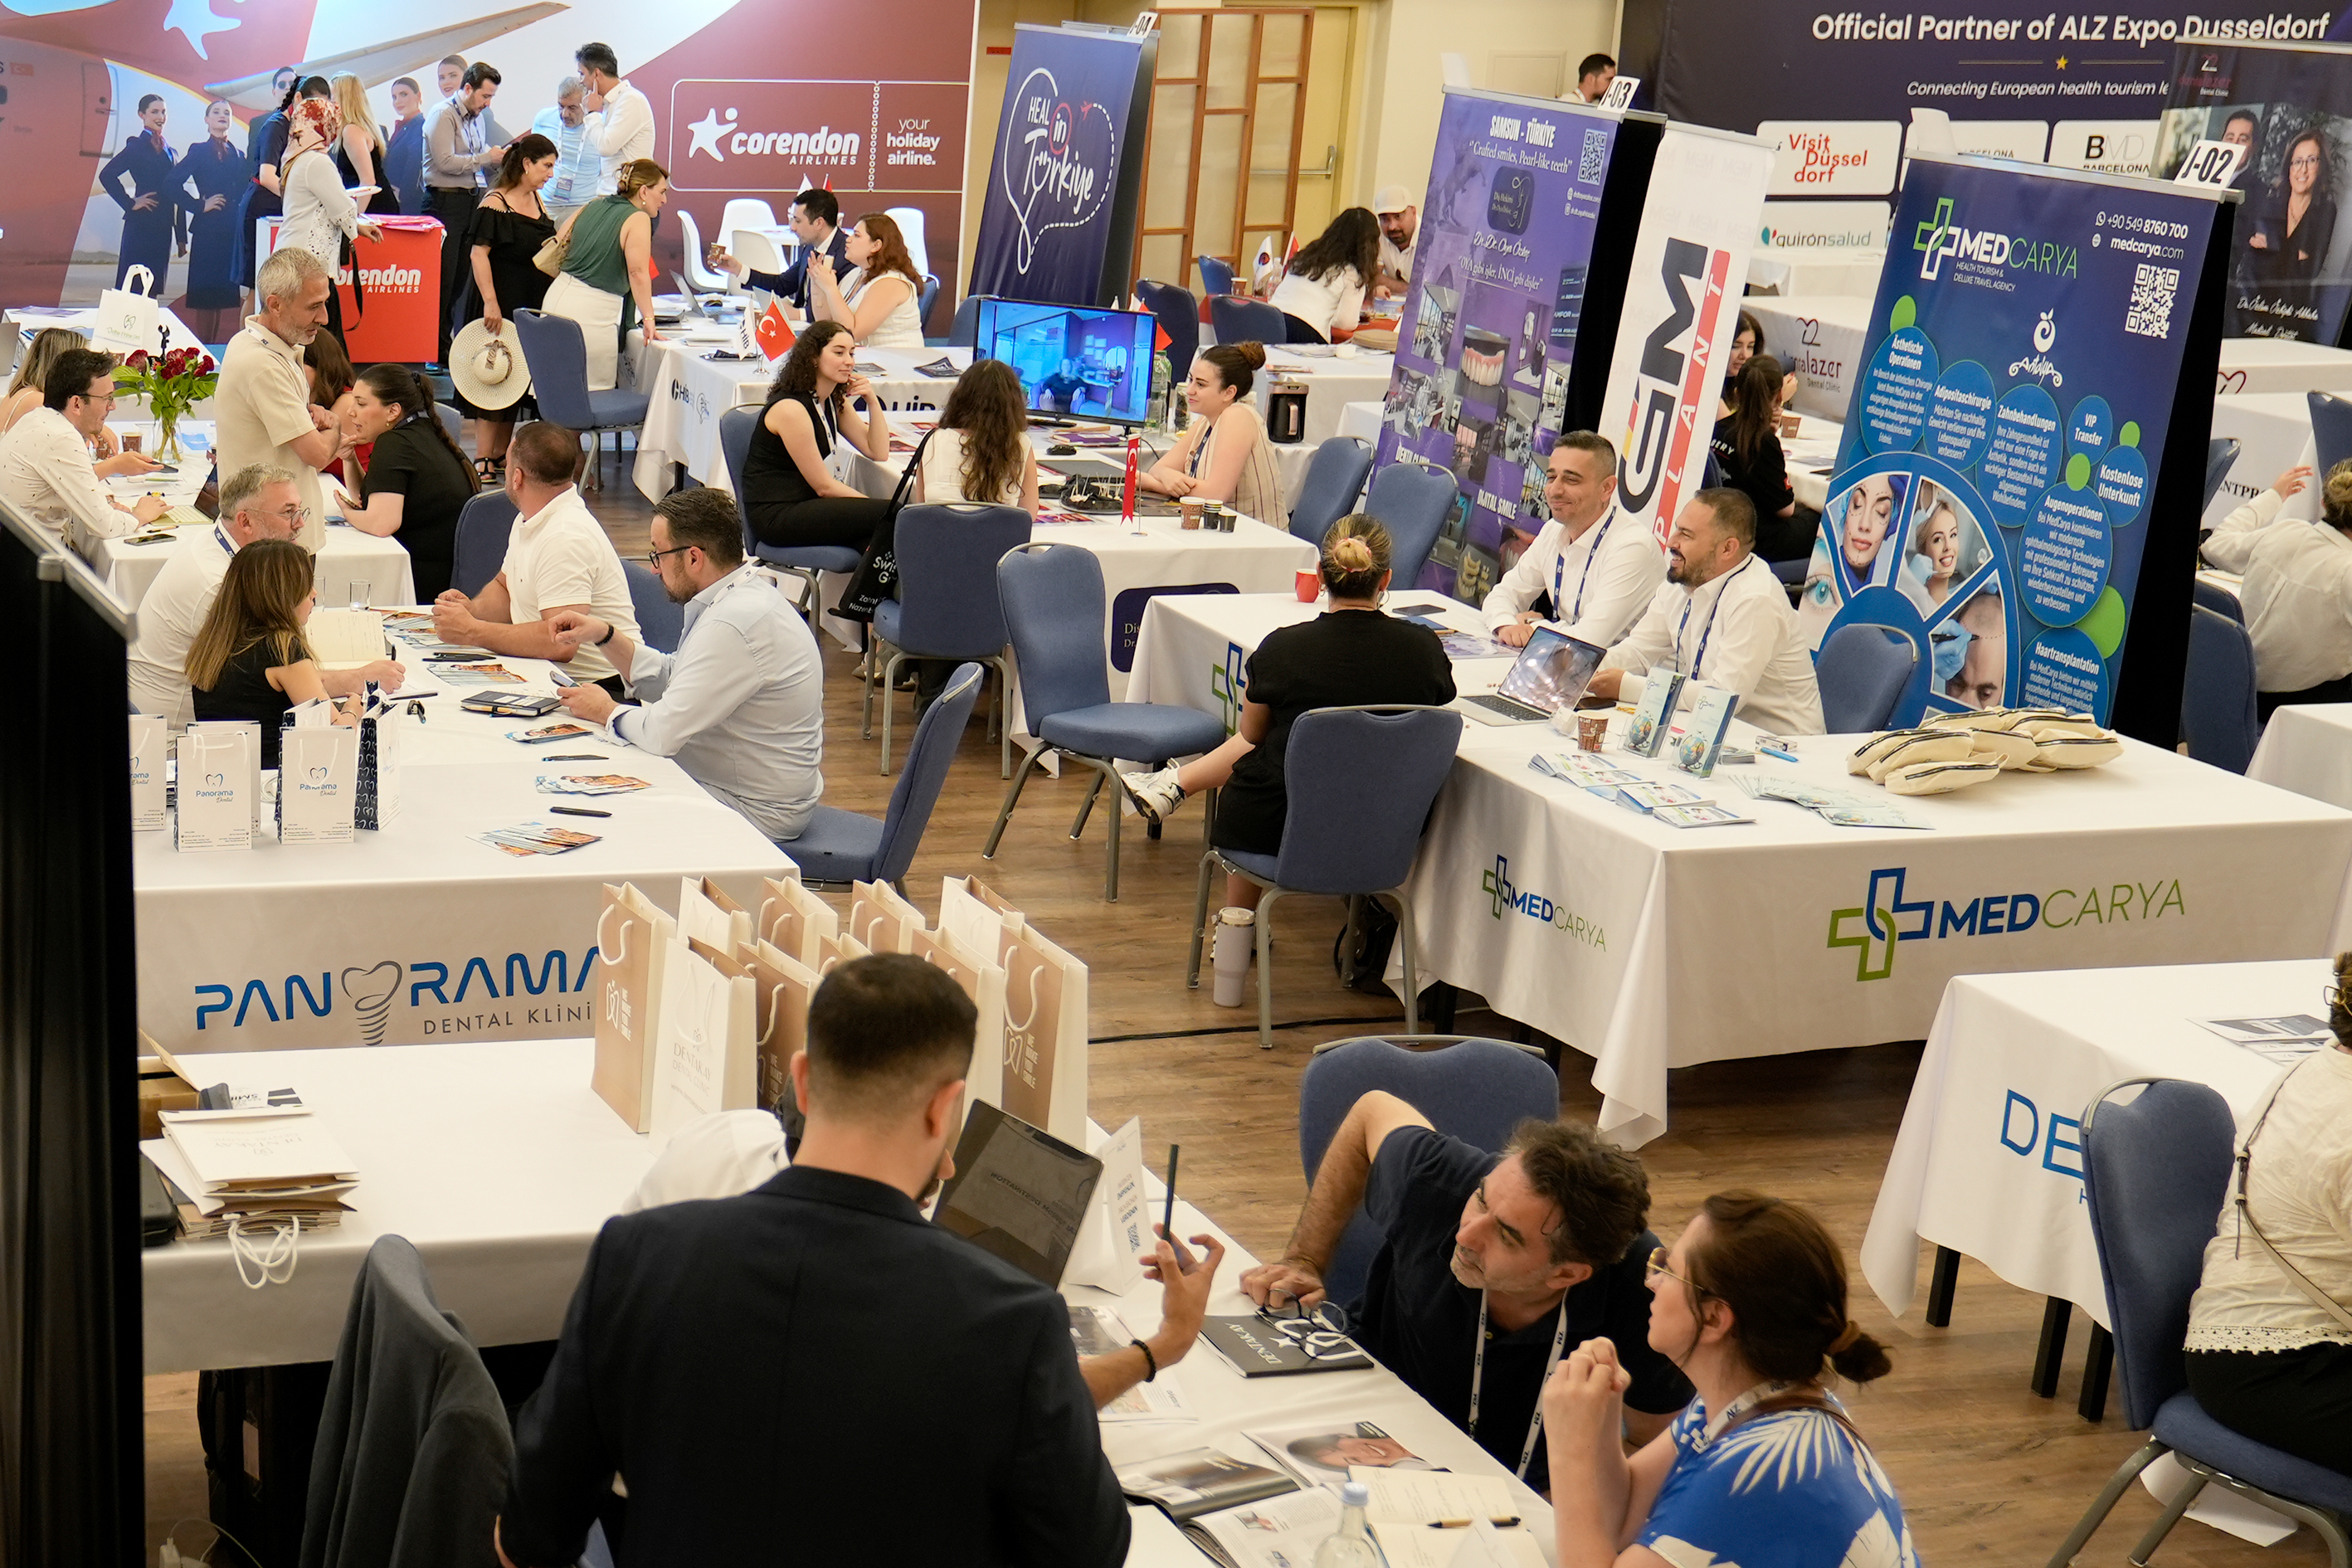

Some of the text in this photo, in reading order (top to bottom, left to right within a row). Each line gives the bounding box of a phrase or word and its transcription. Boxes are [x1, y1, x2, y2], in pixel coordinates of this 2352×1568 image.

[1812, 12, 2331, 48] Official Partner of ALZ Expo Dusseldorf
[1906, 81, 1988, 99] Connecting
[1990, 81, 2055, 99] European
[2057, 81, 2101, 95] health
[2104, 80, 2156, 95] tourism
[1028, 96, 1051, 125] HEAL
[898, 117, 931, 133] your
[1054, 113, 1067, 144] in
[1490, 115, 1521, 141] SAMSUN
[1526, 118, 1556, 149] TÜRKİYE
[730, 125, 860, 155] corendon
[886, 133, 941, 151] holiday
[1789, 134, 1830, 152] Visit
[2085, 134, 2145, 161] BMD
[789, 155, 857, 165] AIRLINES
[887, 151, 937, 166] airline.
[1497, 146, 1518, 164] smiles,
[1519, 150, 1551, 170] Pearl-like
[1805, 150, 1868, 167] Düssel
[2180, 146, 2233, 184] J-02
[1024, 128, 1094, 215] Türkiye
[1794, 164, 1835, 183] dorf
[2107, 213, 2189, 240] +90 549 8760 700
[1958, 228, 2077, 279] MEDCARYA
[2111, 236, 2184, 260] medcarya.com
[1955, 261, 2004, 278] HEALTH TOURISM &
[367, 285, 420, 294] AIRLINES
[1953, 272, 2016, 292] DELUXE TRAVEL AGENCY
[1892, 334, 1924, 355] Ästhetische
[1889, 351, 1921, 371] Operationen
[2009, 353, 2063, 387] Antalya
[1934, 384, 1991, 411] Adipositaschirurgie
[1934, 404, 1954, 419] Möchten
[1953, 408, 1961, 421] Sie
[1997, 404, 2056, 432] Zahnbehandlungen
[2084, 413, 2097, 428] VIP
[1966, 426, 1977, 438] und
[1976, 427, 1986, 440] Ihre
[2074, 427, 2102, 446] Transfer
[2038, 450, 2048, 461] der
[2101, 464, 2144, 489] Kostenlose
[2098, 483, 2141, 508] Unterkunft
[1497, 497, 1517, 520] SMILE
[2044, 494, 2103, 523] Augenoperationen
[2034, 641, 2100, 675] Haartransplantation
[1510, 887, 1606, 952] MEDCARYA
[1938, 879, 2185, 939] MEDCARYA
[424, 1009, 514, 1035] DENTAL
[1225, 1322, 1283, 1365] DENTAKAY
